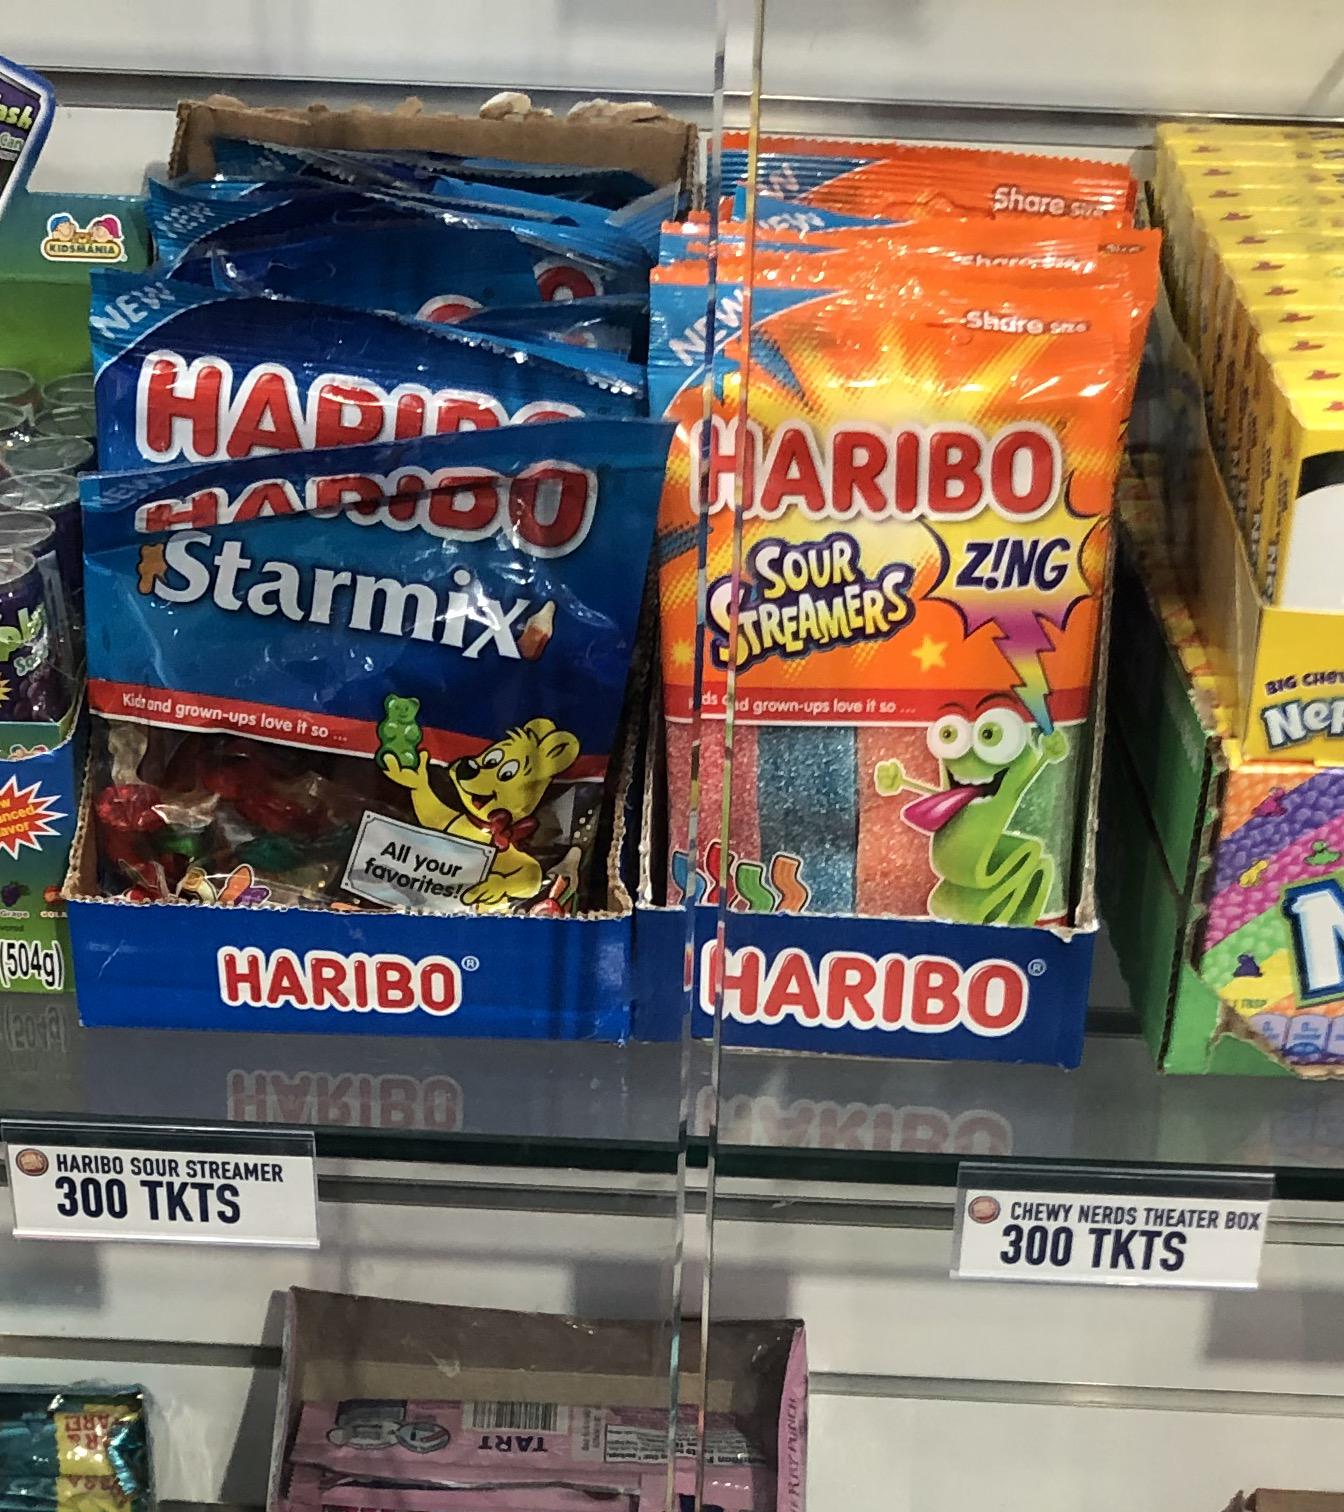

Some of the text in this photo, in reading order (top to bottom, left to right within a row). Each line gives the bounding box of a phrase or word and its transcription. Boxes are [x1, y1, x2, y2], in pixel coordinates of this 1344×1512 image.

[92, 281, 176, 340] NEW
[691, 417, 1062, 523] HARIBO
[755, 536, 858, 600] SOUR
[155, 531, 530, 661] Starmix
[709, 567, 912, 670] STREAMERS
[174, 701, 293, 732] grown-ups love
[364, 857, 464, 901] favorites!
[381, 840, 464, 879] All your
[218, 946, 462, 1015] HARIBO
[700, 939, 1029, 1037] HARIBO
[56, 1153, 284, 1183] HARIBO SOUR STREAMER
[55, 1176, 241, 1224] 300 TKTS
[1010, 1202, 1262, 1231] CHEWY NERDS THEATER BOX
[1000, 1224, 1187, 1272] 300 TKTS
